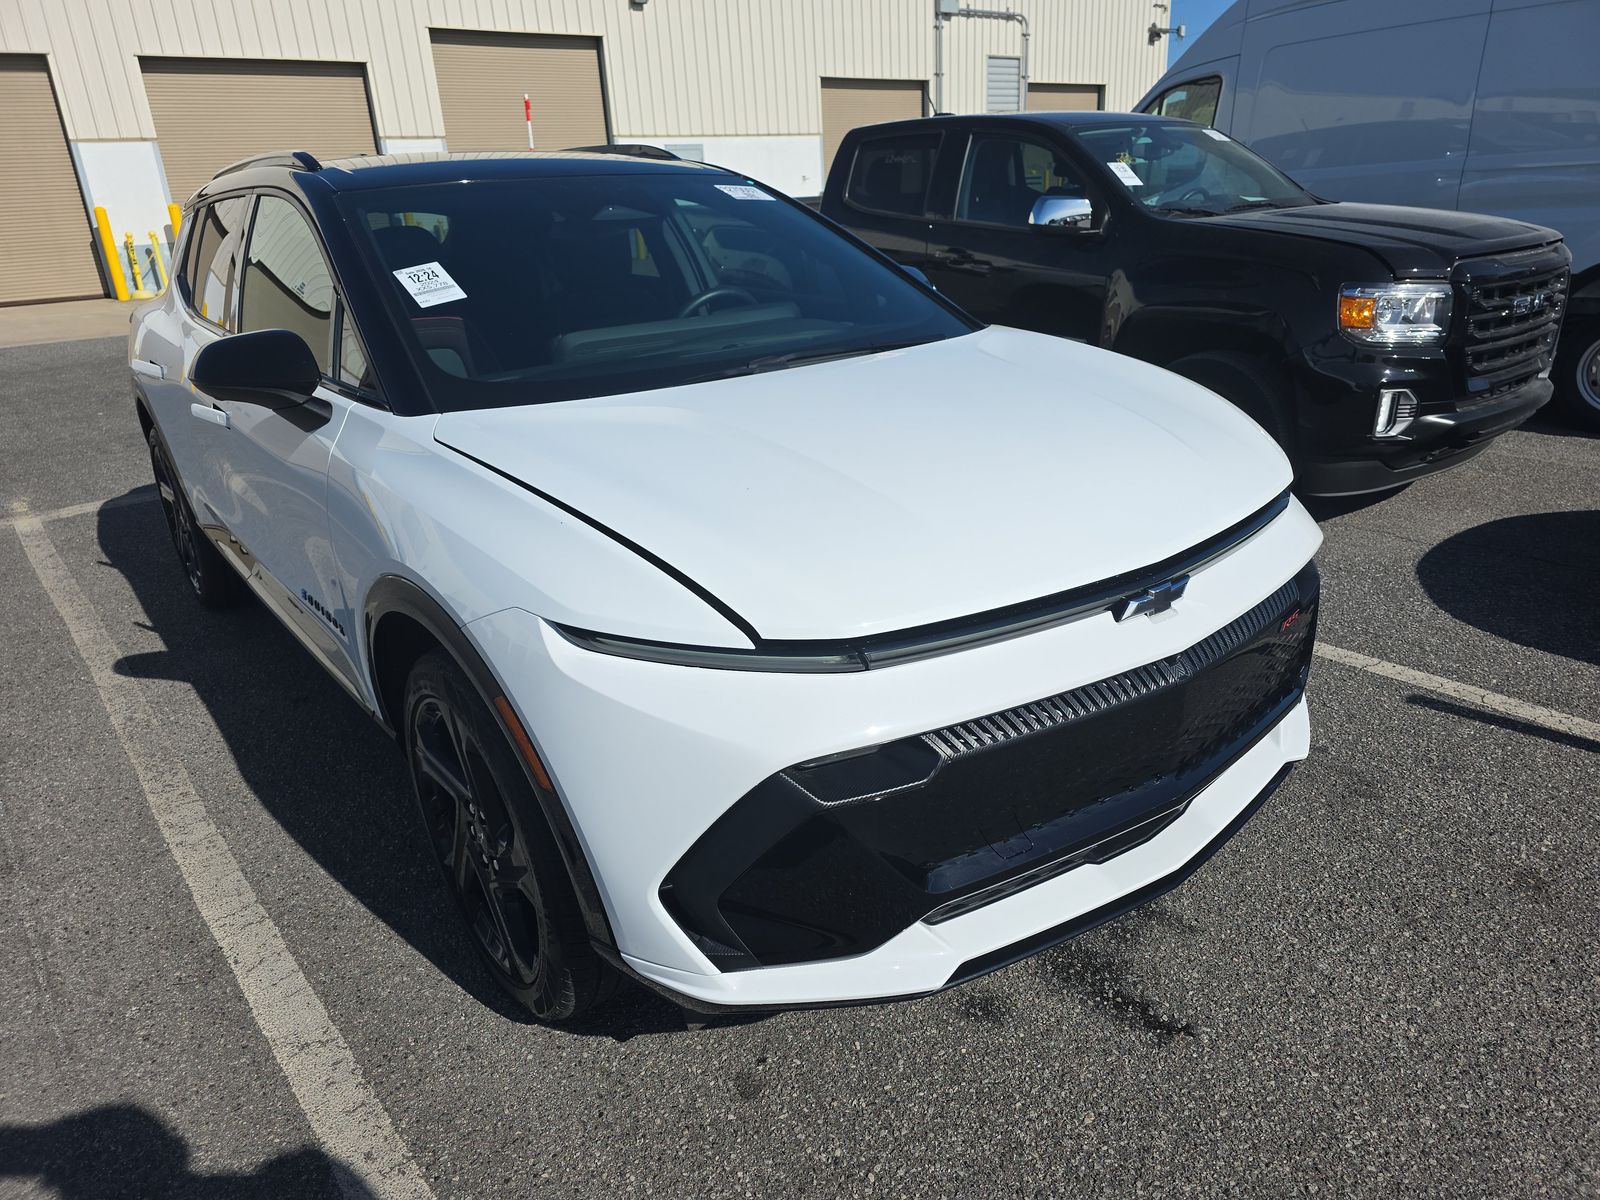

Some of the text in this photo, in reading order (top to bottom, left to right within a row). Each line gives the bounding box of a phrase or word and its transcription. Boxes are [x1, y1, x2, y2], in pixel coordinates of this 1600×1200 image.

[407, 270, 440, 284] 12:24
[301, 588, 346, 637] EQUINOX
[1282, 608, 1300, 631] RS
